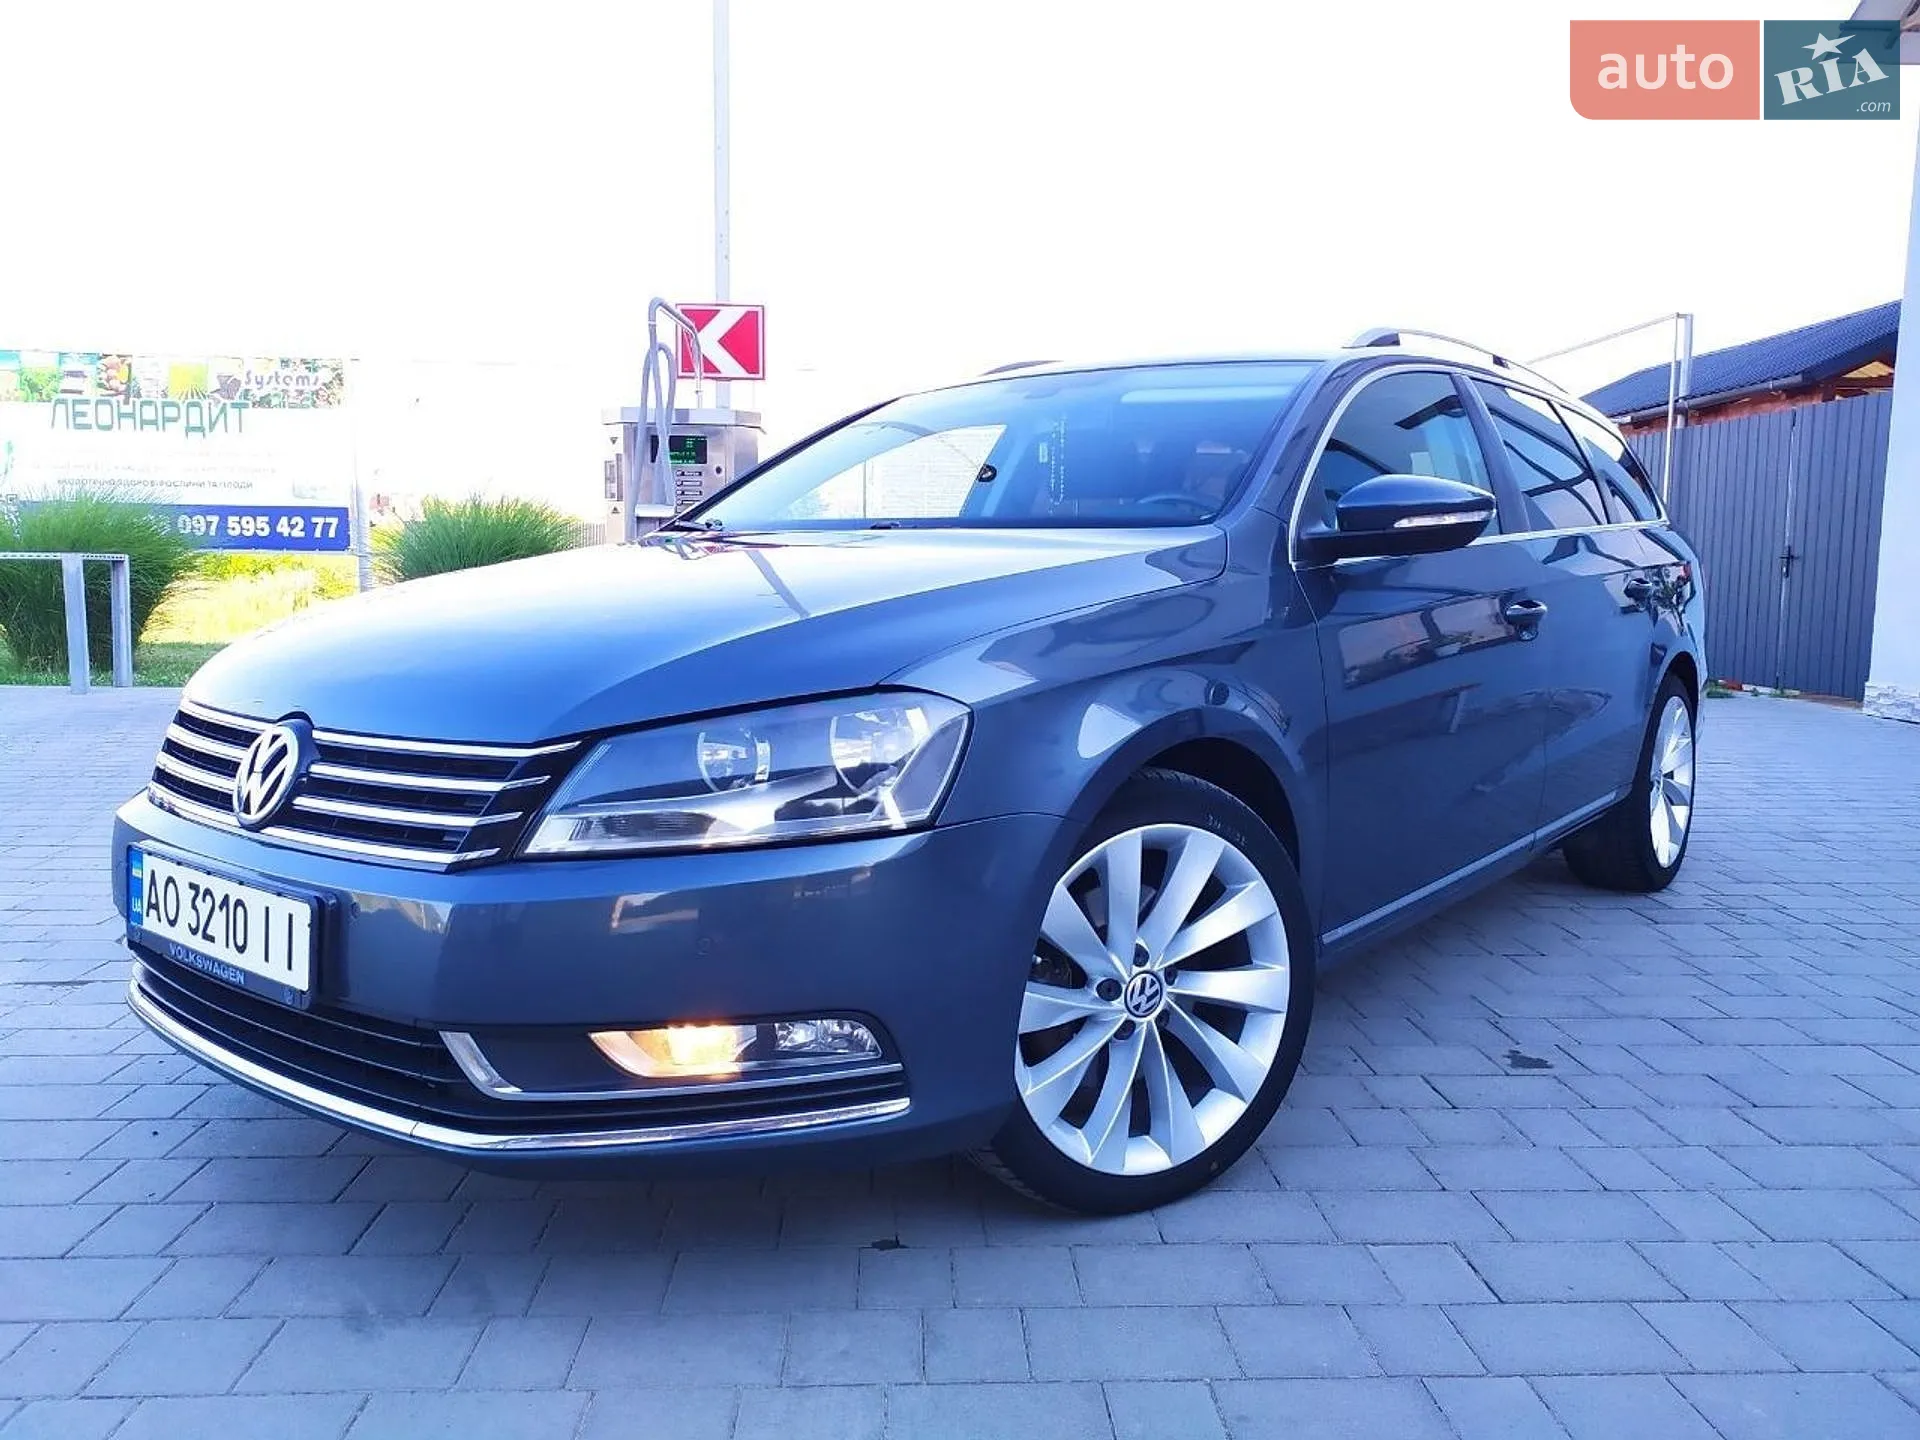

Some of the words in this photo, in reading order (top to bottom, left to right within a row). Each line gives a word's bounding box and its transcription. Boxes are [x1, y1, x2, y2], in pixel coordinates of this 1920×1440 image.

[245, 370, 319, 390] Systems
[51, 398, 250, 439] ЛЕОНАРДИТ
[177, 515, 219, 537] 097
[227, 516, 270, 537] 595
[276, 516, 306, 538] 42
[311, 517, 339, 538] 77
[187, 881, 248, 954] 3210
[169, 943, 245, 985] VOLKSWAGEN
